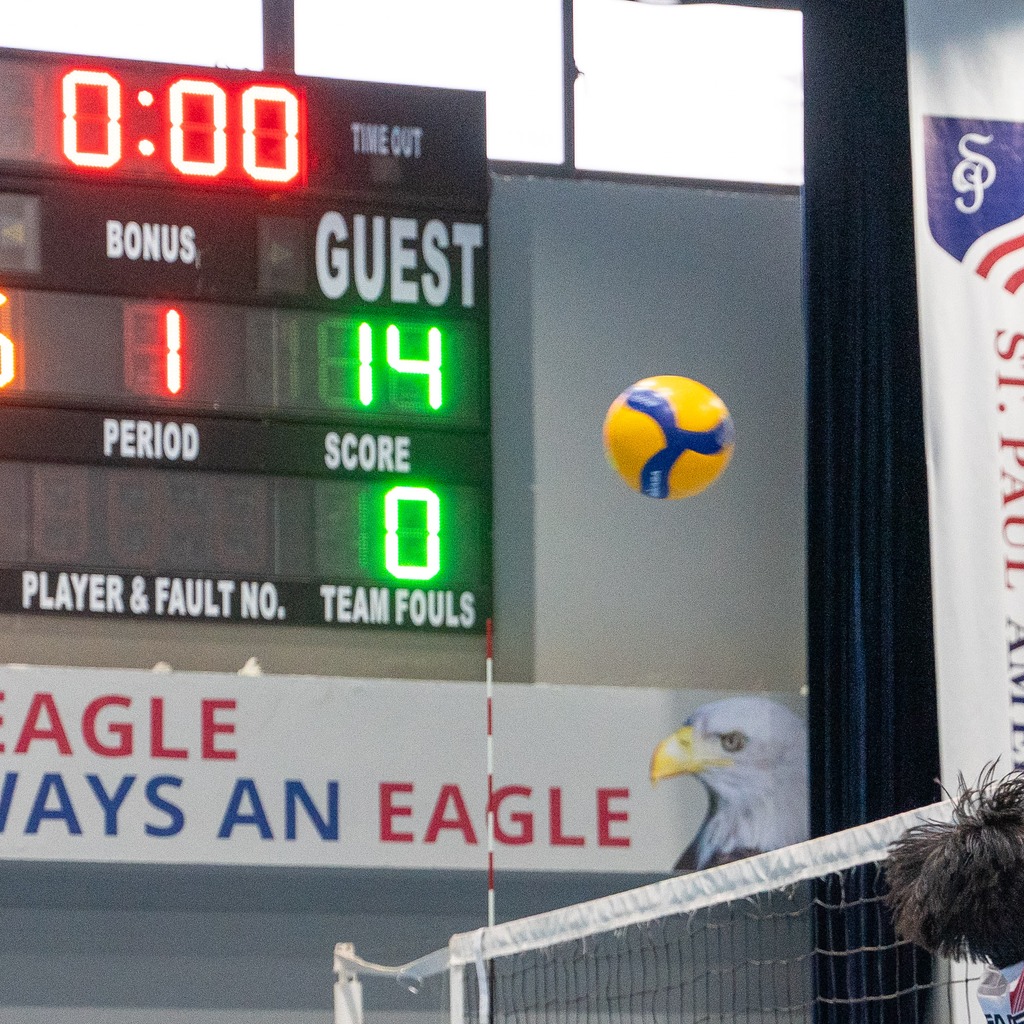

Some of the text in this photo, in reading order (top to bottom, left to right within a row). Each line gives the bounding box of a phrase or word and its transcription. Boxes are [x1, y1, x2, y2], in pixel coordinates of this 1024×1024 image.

[63, 69, 300, 183] 0:00
[350, 122, 423, 159] TIME OUT
[106, 219, 198, 264] BONUS
[315, 211, 484, 308] GUEST
[166, 309, 181, 395] 1
[359, 322, 443, 411] 14
[103, 418, 200, 462] PERIOD
[324, 431, 411, 473] SCORE
[384, 485, 441, 582] 0
[22, 570, 287, 621] PLAYER & FAULT NO.
[320, 585, 476, 629] TEAM FOULS
[0, 692, 238, 761] AGLE
[0, 771, 632, 848] AYS AN EAGLE
